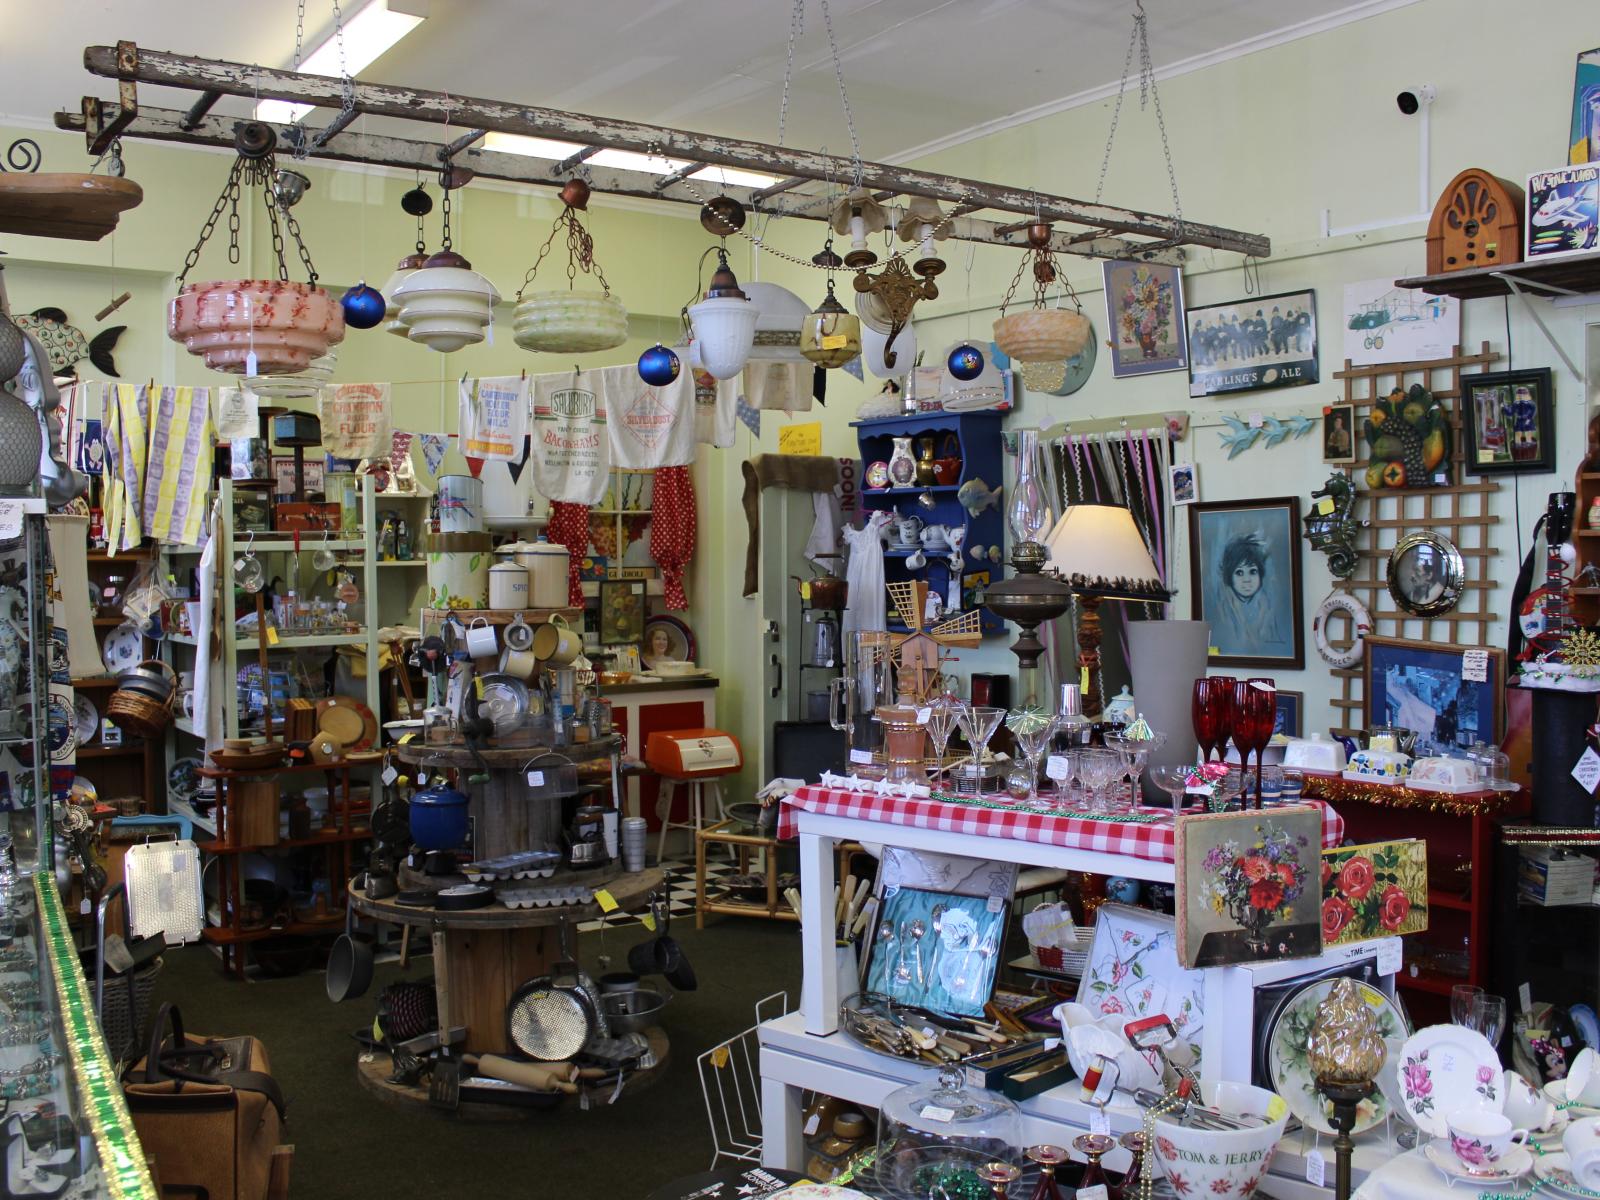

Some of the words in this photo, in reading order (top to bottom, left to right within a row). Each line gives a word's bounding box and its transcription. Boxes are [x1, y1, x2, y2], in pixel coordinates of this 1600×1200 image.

[1280, 367, 1302, 379] ALE
[340, 423, 376, 434] FLOUR
[840, 457, 856, 512] SOON!
[512, 583, 528, 592] SPIC
[1175, 1147, 1206, 1165] TOM
[1208, 1153, 1220, 1165] &
[1225, 1148, 1266, 1165] JERRY
